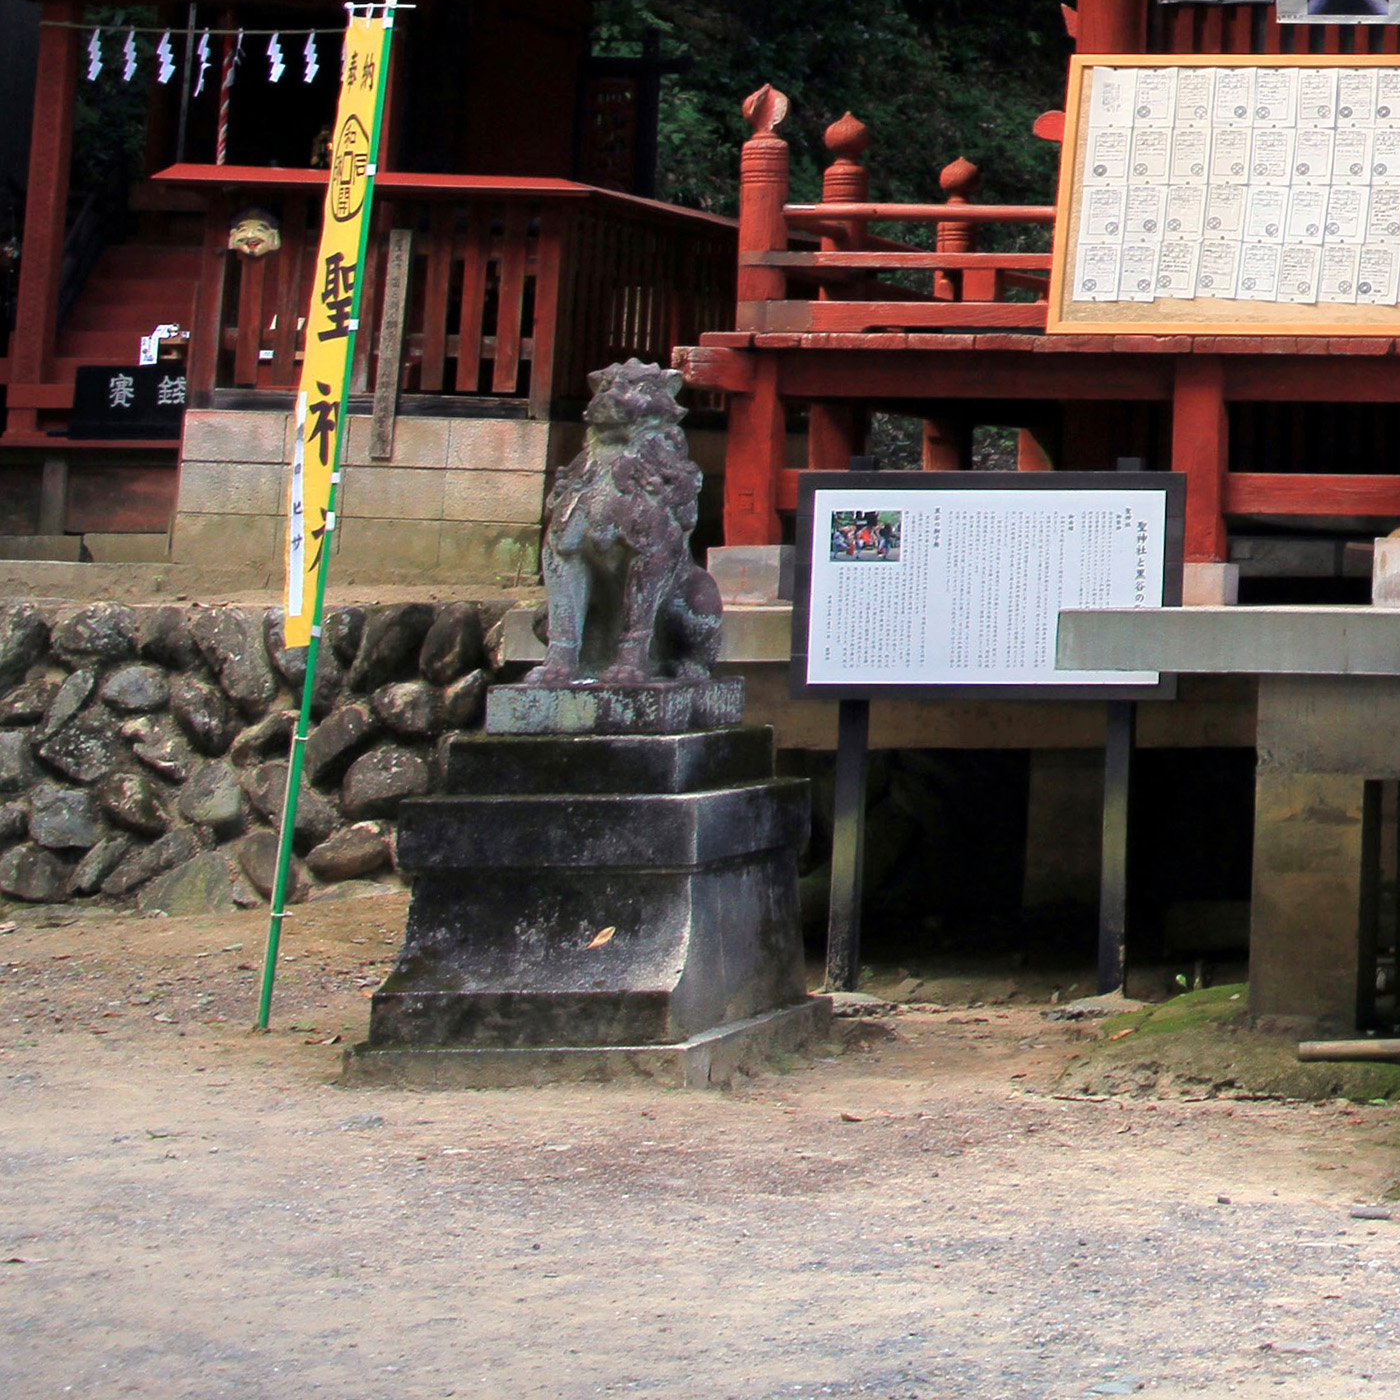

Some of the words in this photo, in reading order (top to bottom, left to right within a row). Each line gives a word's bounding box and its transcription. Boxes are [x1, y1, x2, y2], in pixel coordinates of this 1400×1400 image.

[1134, 520, 1148, 607] 聖神社と黒谷の
